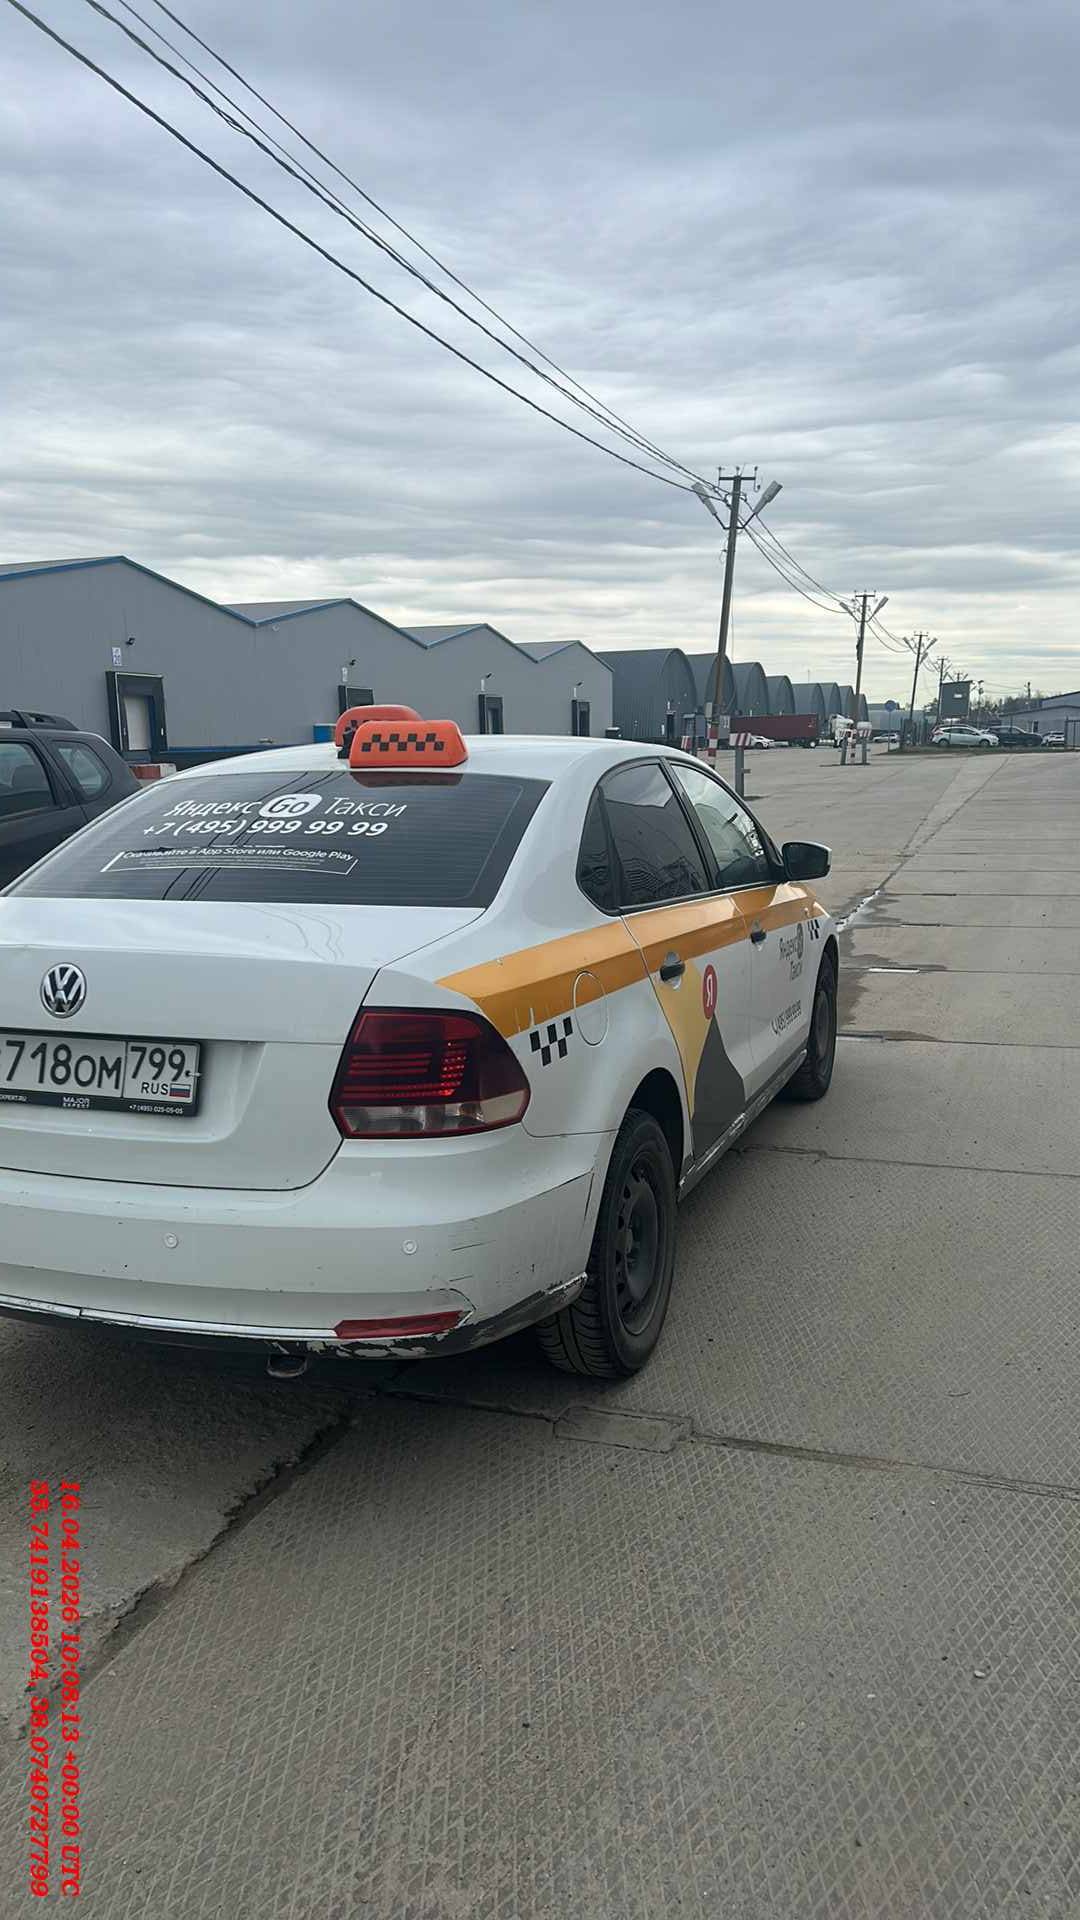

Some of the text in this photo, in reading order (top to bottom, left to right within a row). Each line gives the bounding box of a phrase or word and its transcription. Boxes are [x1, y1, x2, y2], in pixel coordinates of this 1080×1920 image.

[163, 796, 407, 817] Яндекс Go Такси
[143, 819, 389, 837] +7 (495) 999 99 99
[282, 848, 328, 858] Google
[328, 850, 354, 861] Play
[0, 1039, 187, 1090] 718ОМ 799
[140, 1081, 169, 1095] RUS
[63, 1096, 90, 1105] MAJOR
